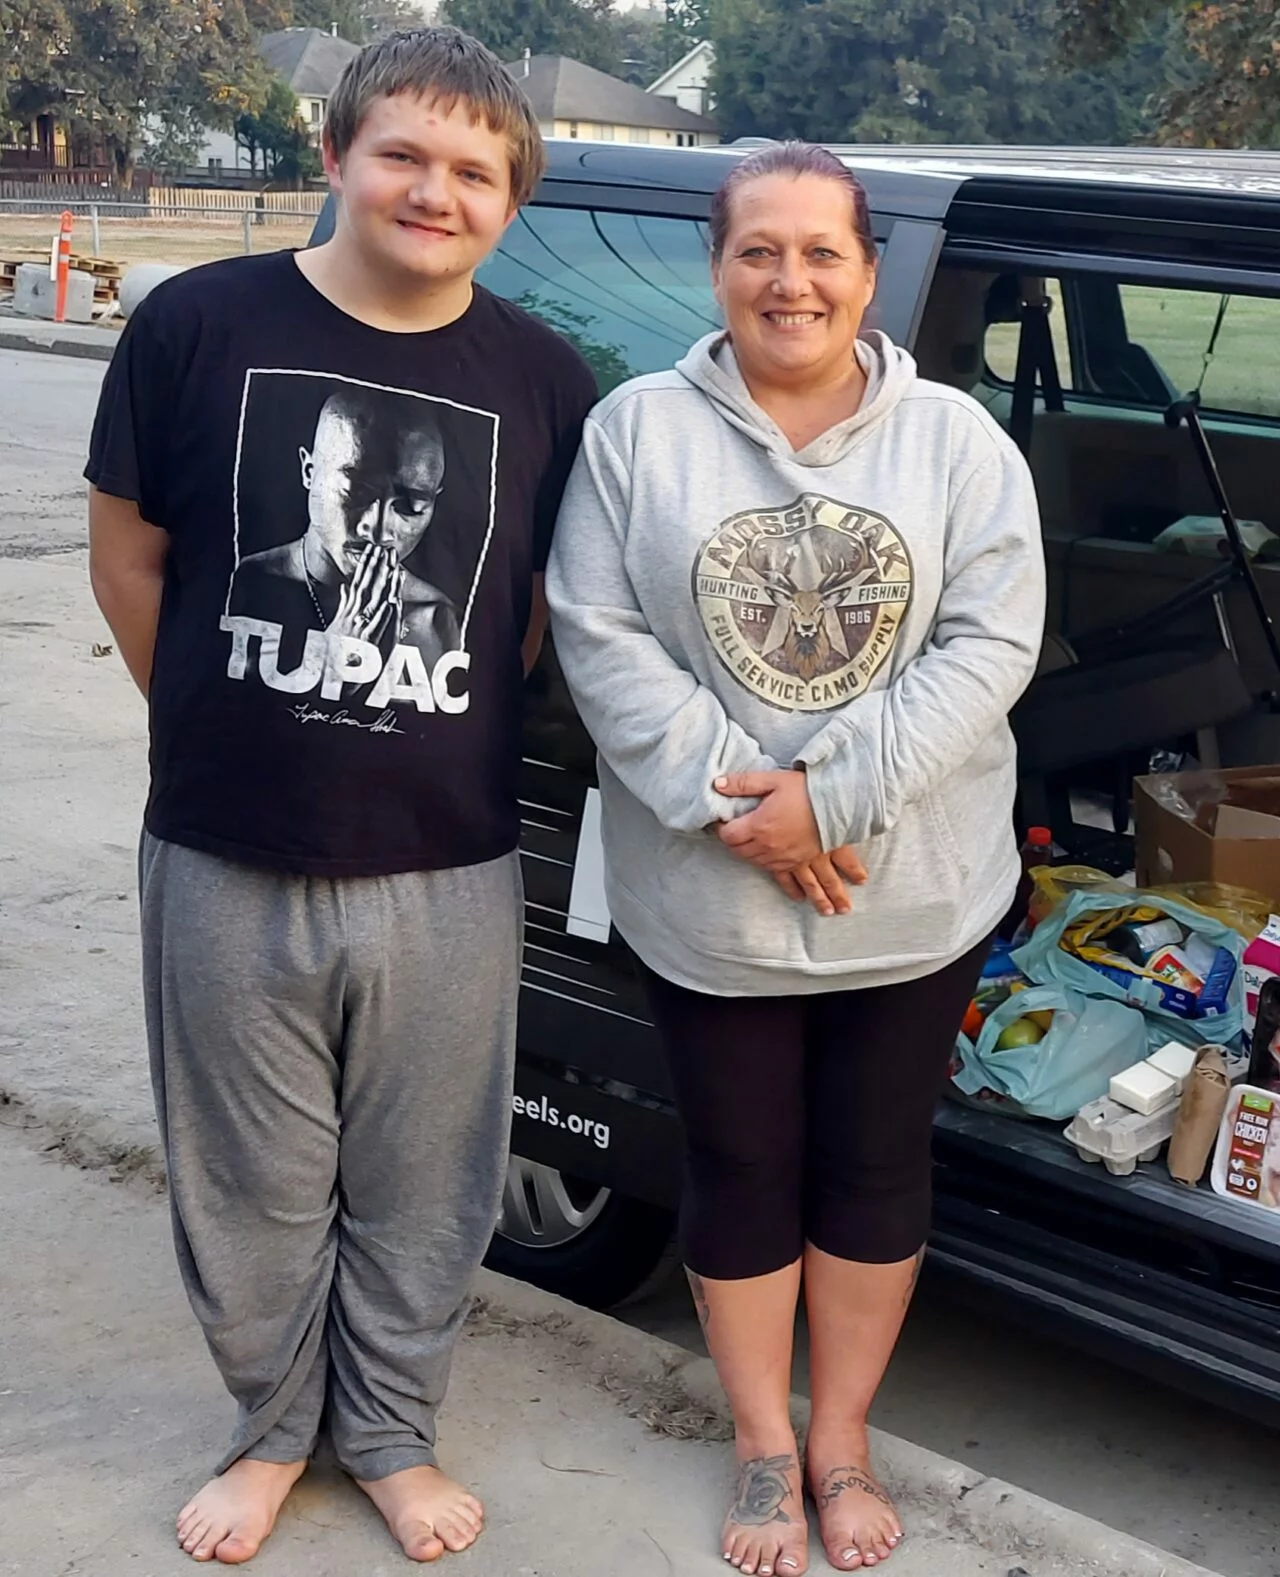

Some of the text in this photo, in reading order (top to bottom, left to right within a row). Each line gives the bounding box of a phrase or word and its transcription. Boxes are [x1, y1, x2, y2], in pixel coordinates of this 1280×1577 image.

[707, 500, 908, 576] MOSSY OAK
[700, 578, 758, 600] HUNTING
[740, 607, 766, 623] EST.
[858, 585, 907, 602] FISHING
[219, 614, 471, 715] TUPAC
[710, 613, 896, 702] FULL SERVICE CAMO SUPPLY
[512, 1095, 610, 1149] eels.org
